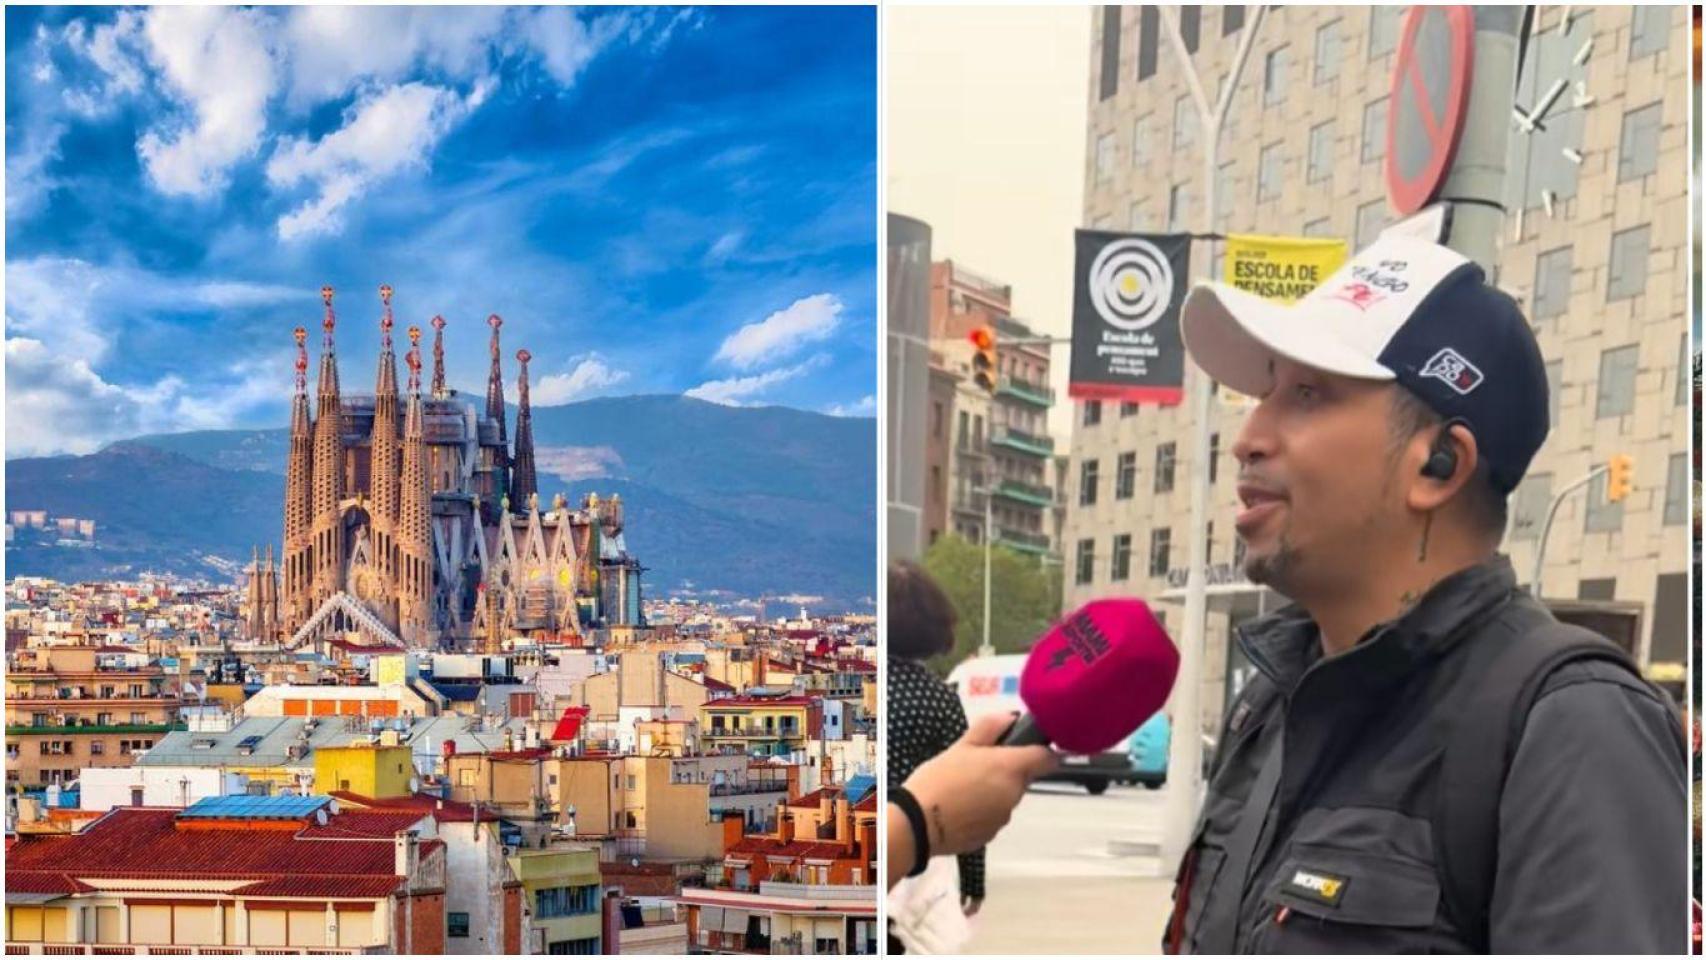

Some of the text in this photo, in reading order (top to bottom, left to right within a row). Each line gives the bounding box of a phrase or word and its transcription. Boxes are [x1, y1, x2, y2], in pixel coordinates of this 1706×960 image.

[1234, 260, 1319, 281] ESCOLA DE
[1102, 330, 1155, 345] Escola de
